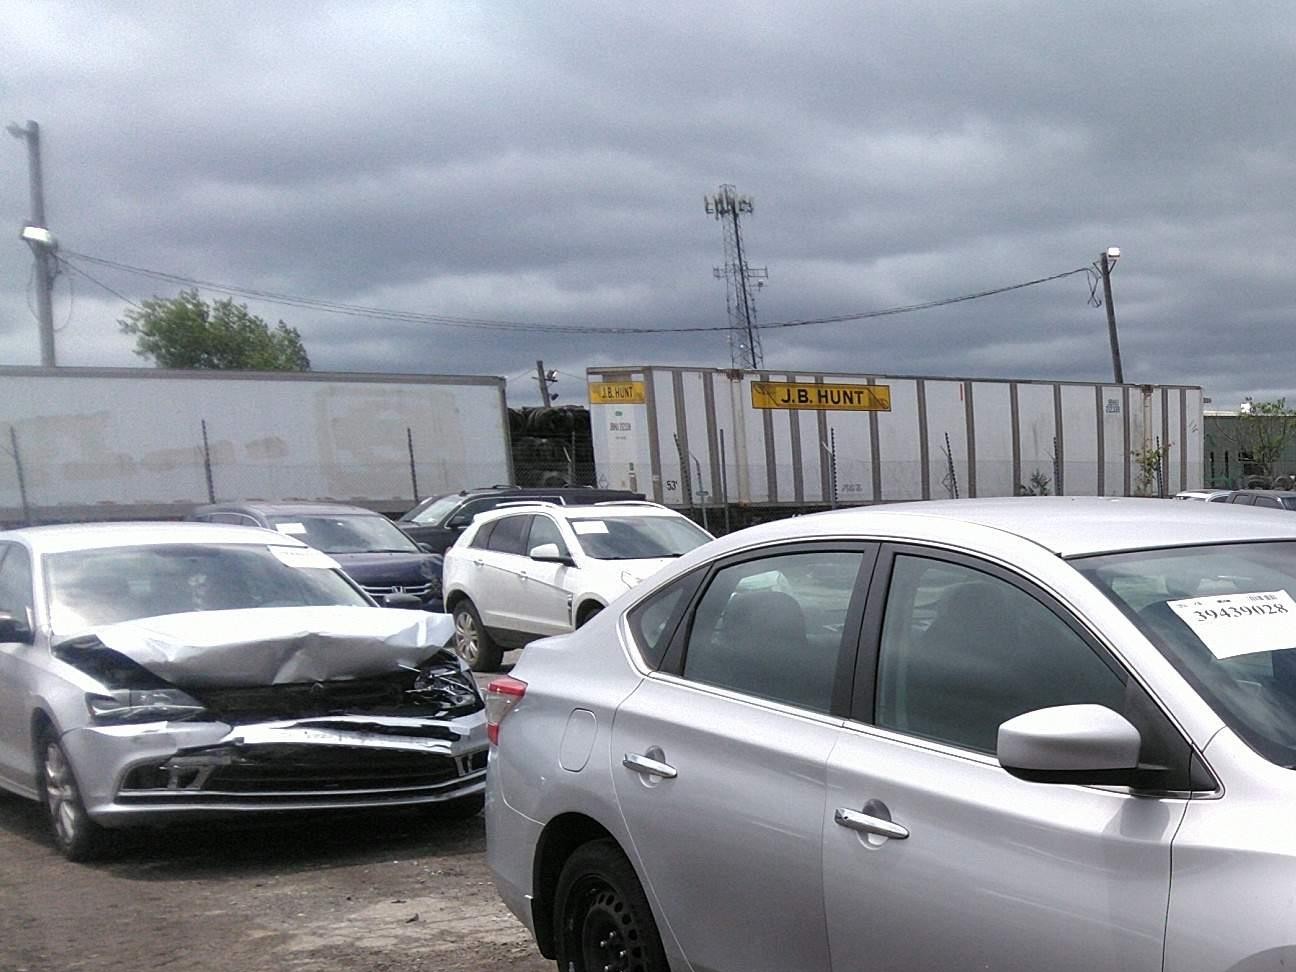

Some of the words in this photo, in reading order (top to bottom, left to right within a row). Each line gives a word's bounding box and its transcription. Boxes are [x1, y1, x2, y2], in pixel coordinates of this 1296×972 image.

[615, 385, 633, 399] HUNT
[781, 388, 813, 404] J.B.
[817, 389, 864, 405] HUNT
[1193, 603, 1289, 622] 39439028
